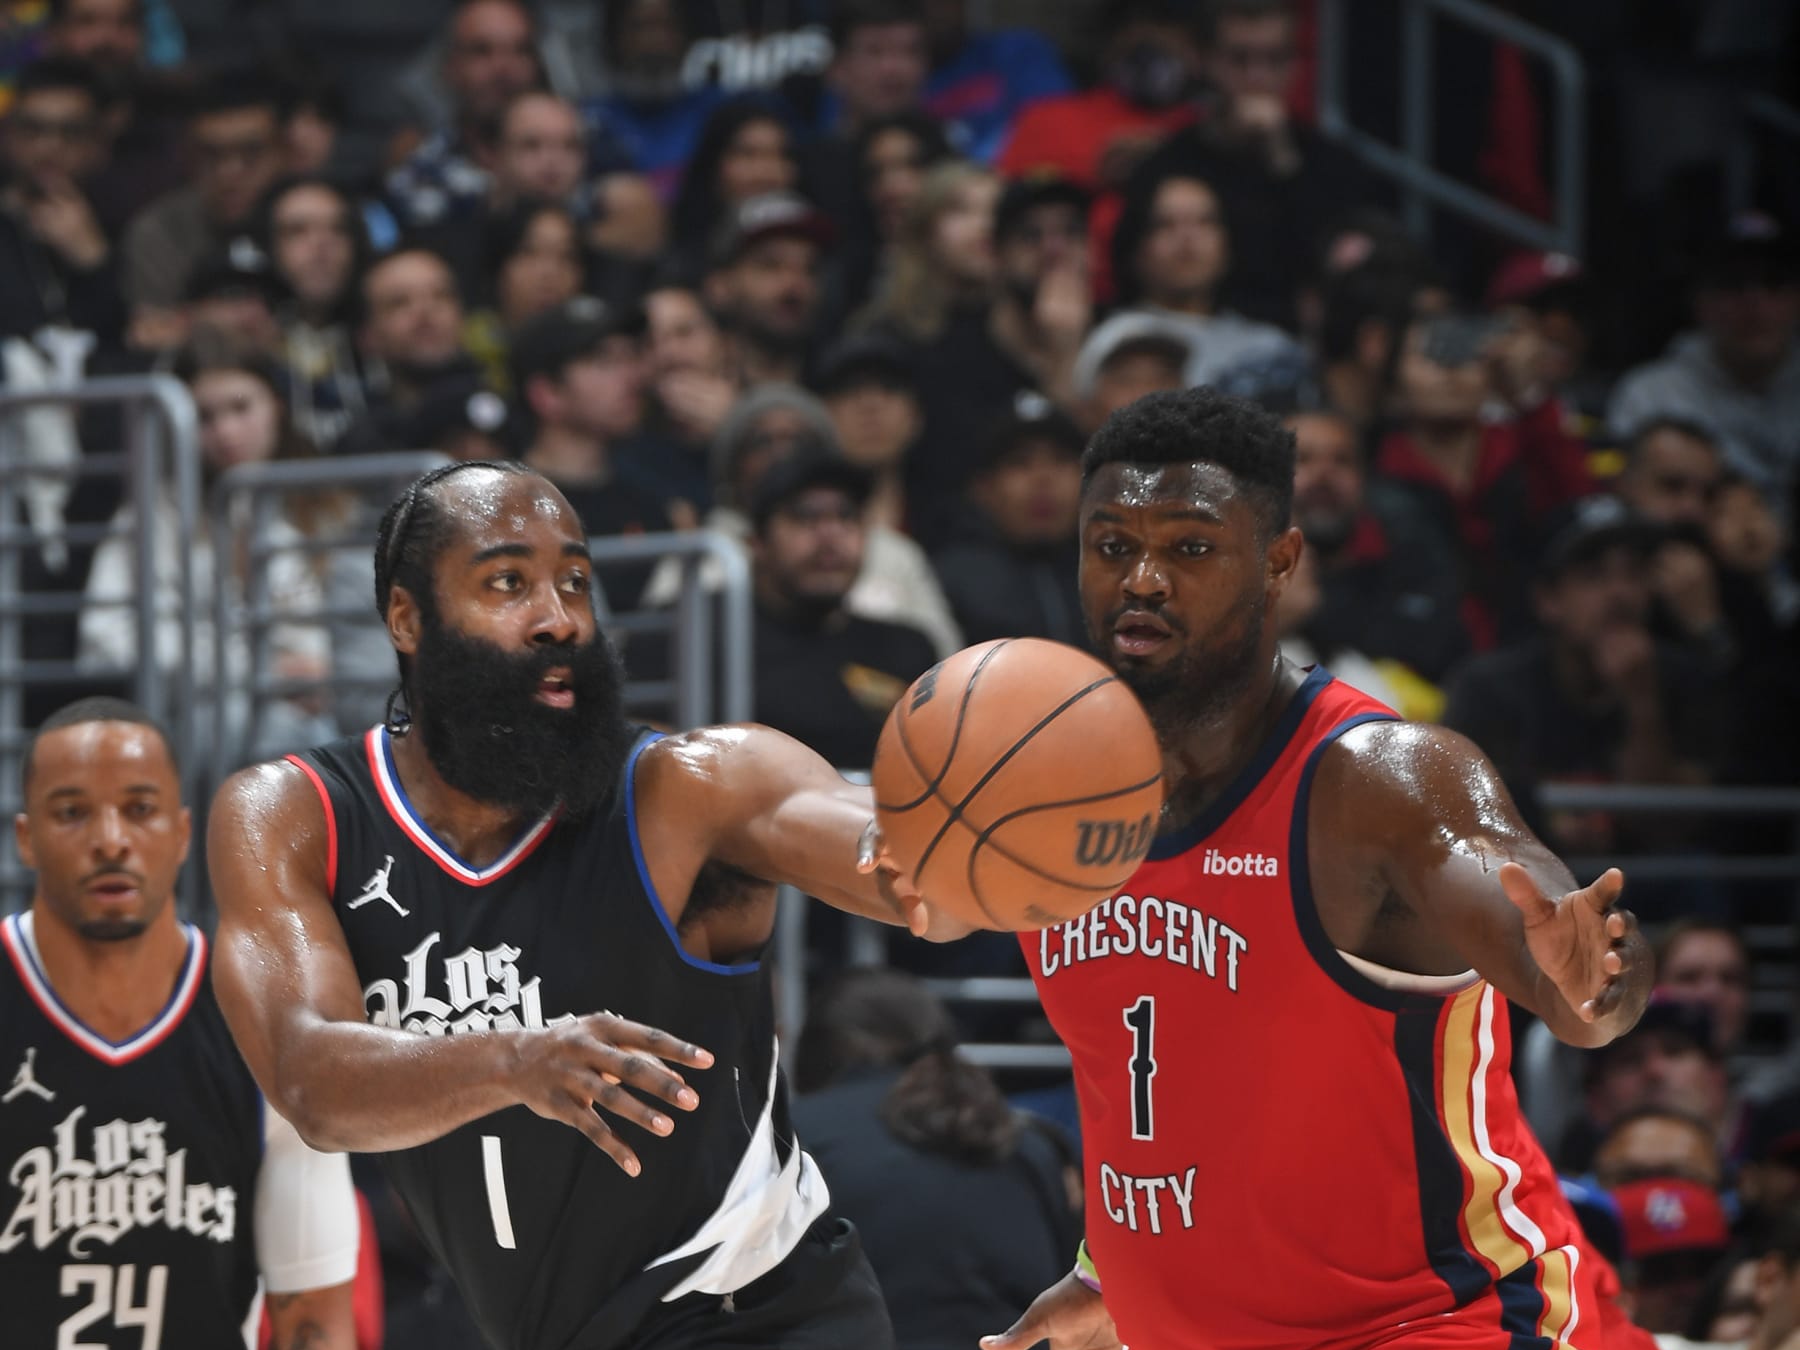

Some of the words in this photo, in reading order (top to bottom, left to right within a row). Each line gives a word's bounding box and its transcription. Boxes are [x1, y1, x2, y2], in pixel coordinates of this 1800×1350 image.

[1203, 849, 1279, 877] ibotta
[401, 931, 523, 1021] Los
[1040, 895, 1247, 992] CRESCENT
[1122, 995, 1158, 1141] 1
[52, 1104, 168, 1180] Los
[0, 1146, 237, 1260] Angeles
[481, 1135, 517, 1250] 1
[1100, 1162, 1197, 1235] CITY
